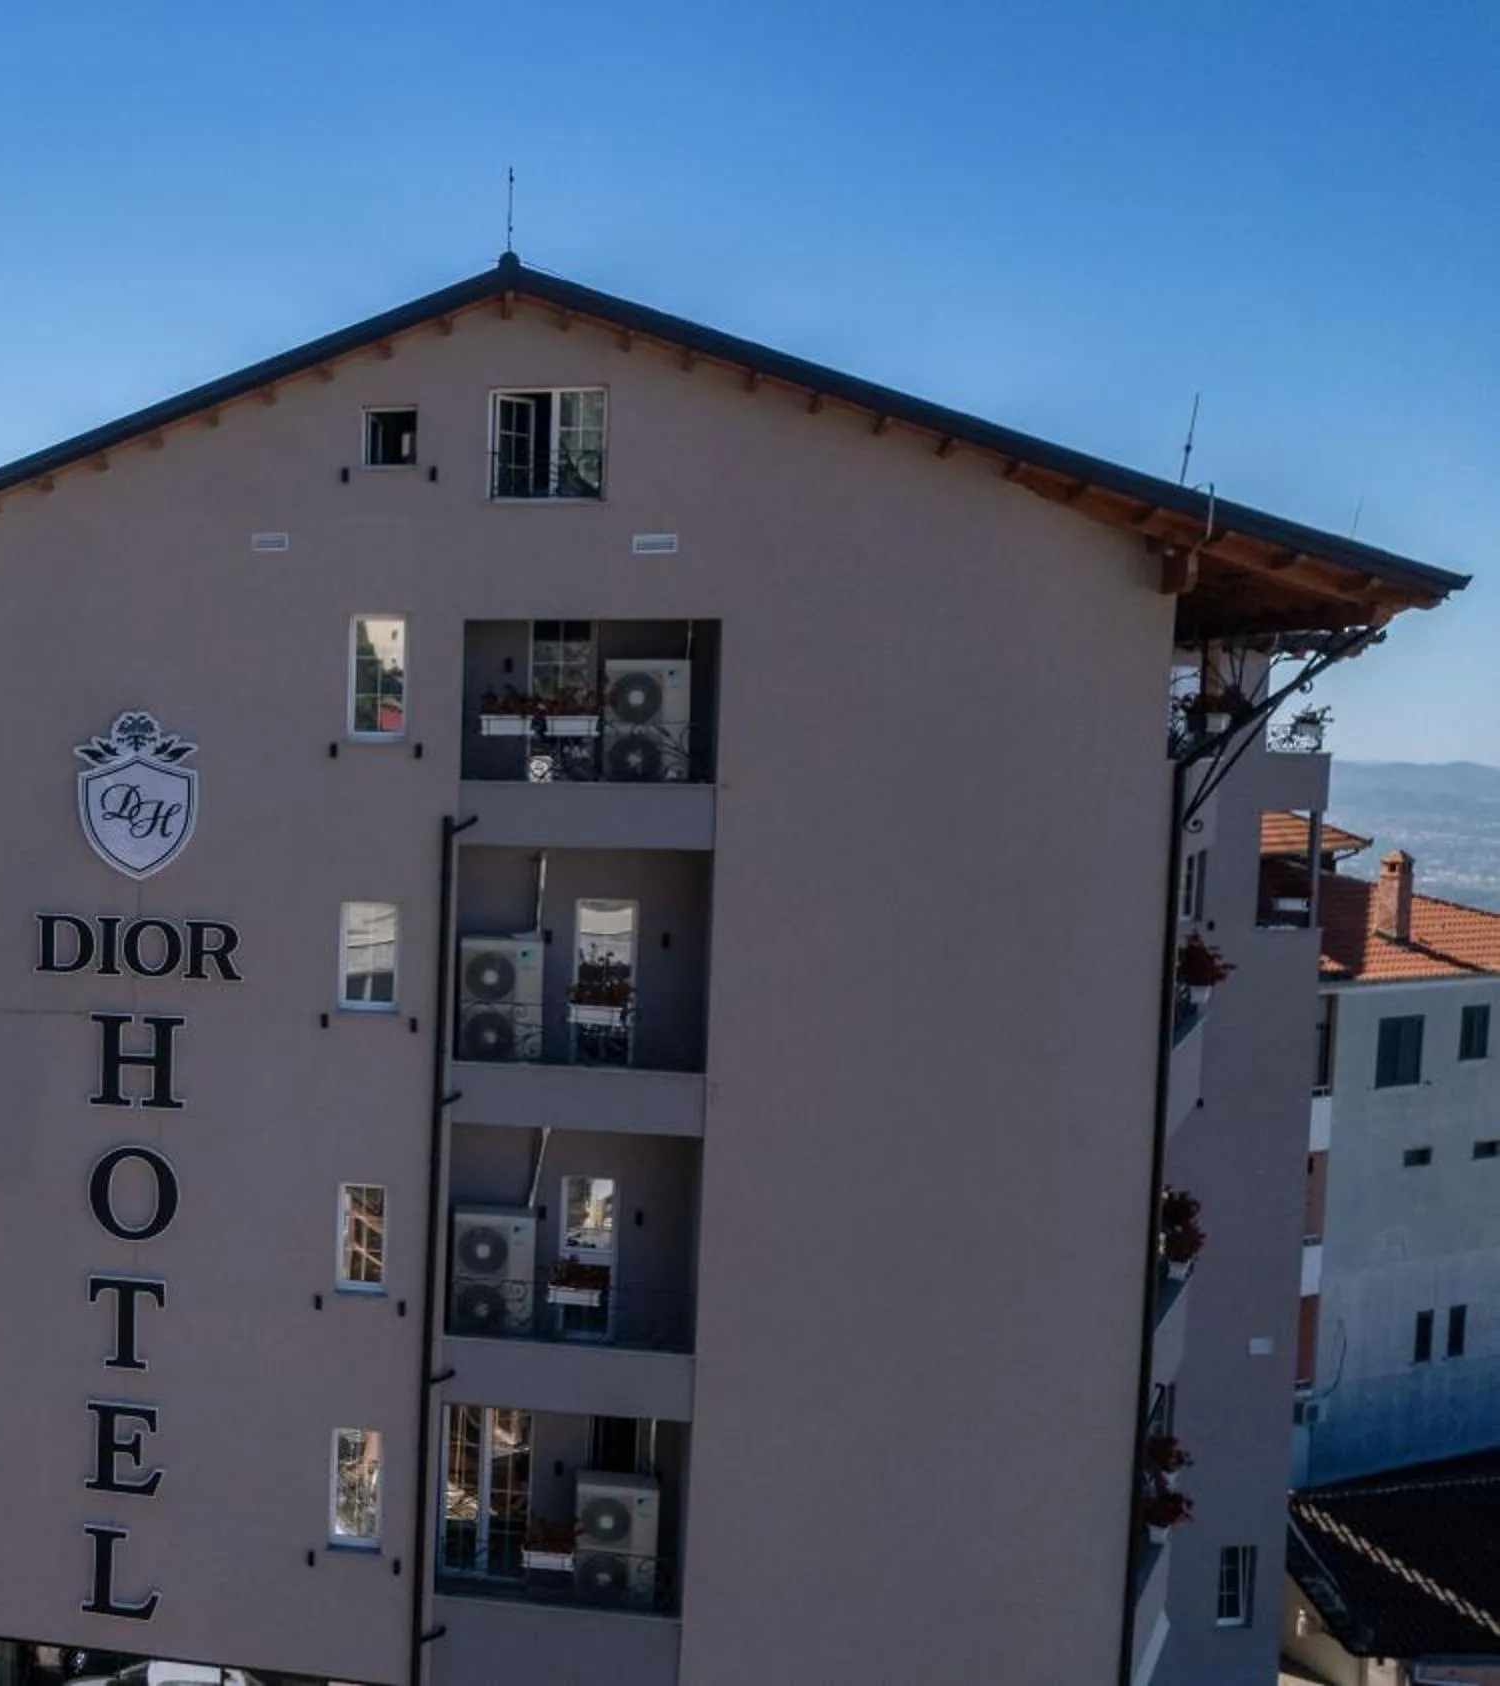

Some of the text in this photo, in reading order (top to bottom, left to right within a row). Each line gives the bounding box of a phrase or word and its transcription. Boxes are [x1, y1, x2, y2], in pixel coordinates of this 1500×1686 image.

[100, 783, 182, 839] DH
[35, 913, 243, 981] DIOR
[81, 1012, 186, 1621] HOTEL
